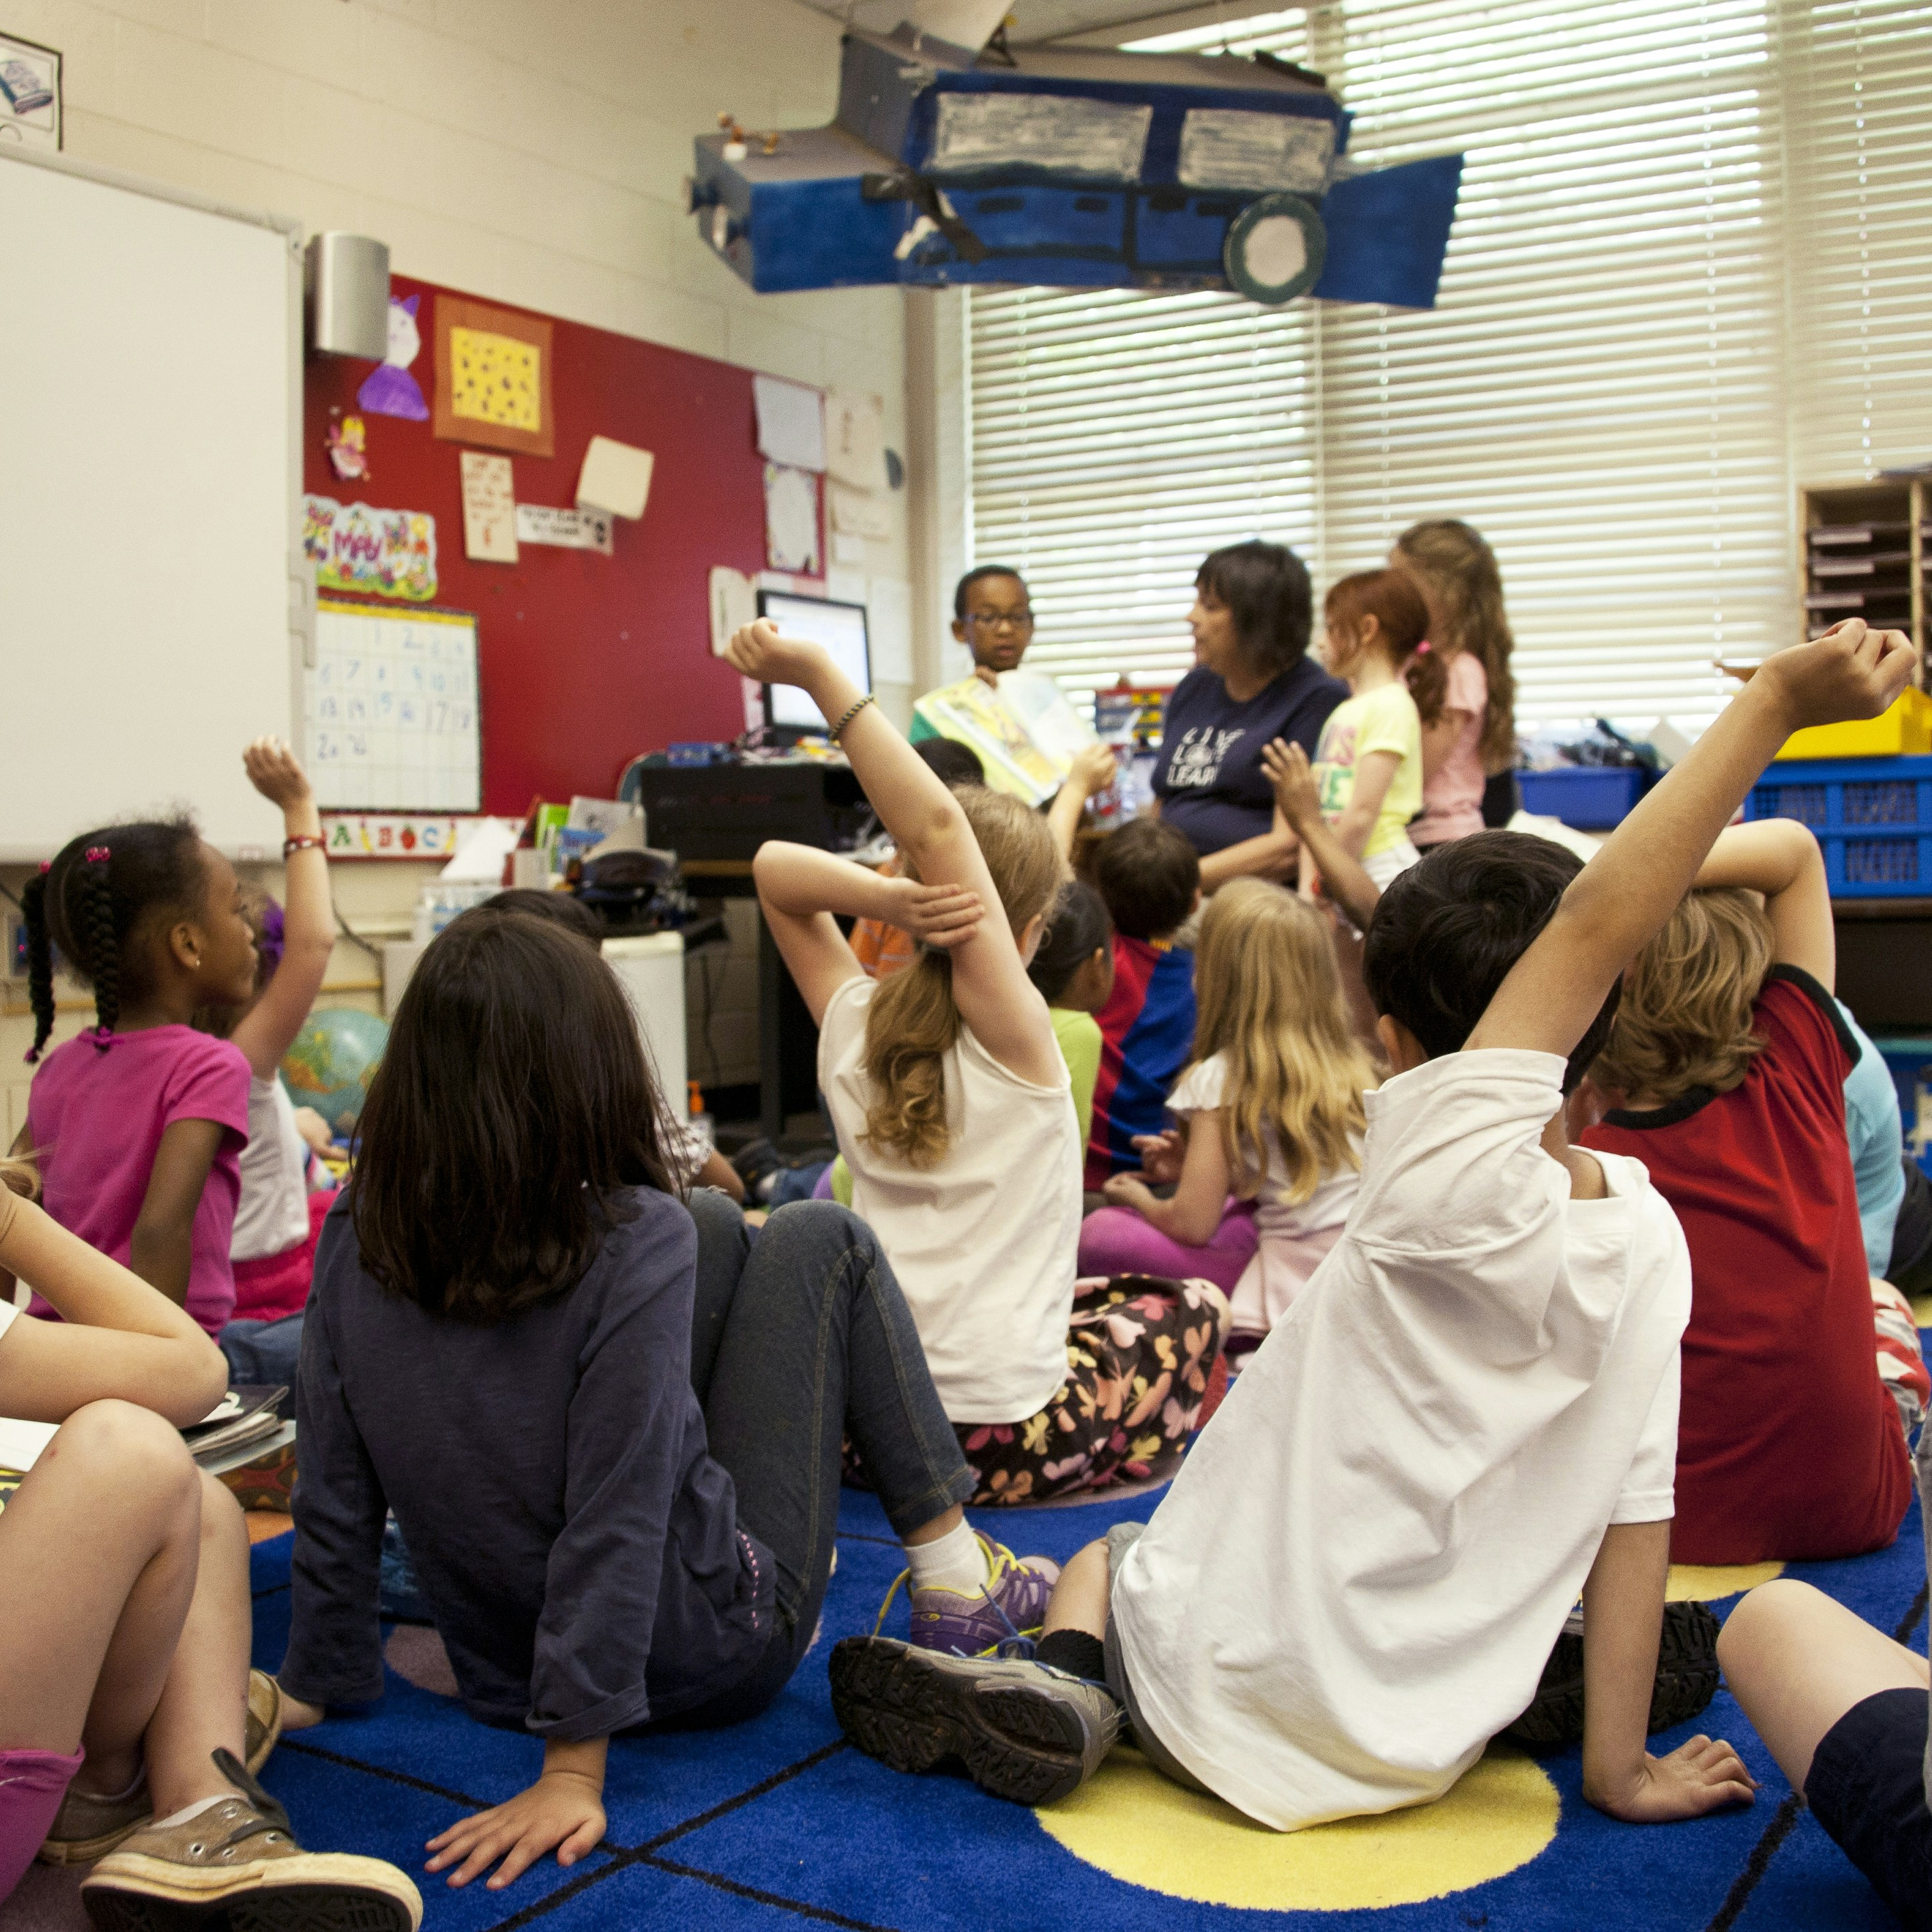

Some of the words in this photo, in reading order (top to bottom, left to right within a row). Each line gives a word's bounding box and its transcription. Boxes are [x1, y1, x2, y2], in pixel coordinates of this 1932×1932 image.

[332, 825, 351, 847] A
[379, 827, 393, 847] B
[422, 826, 439, 848] C
